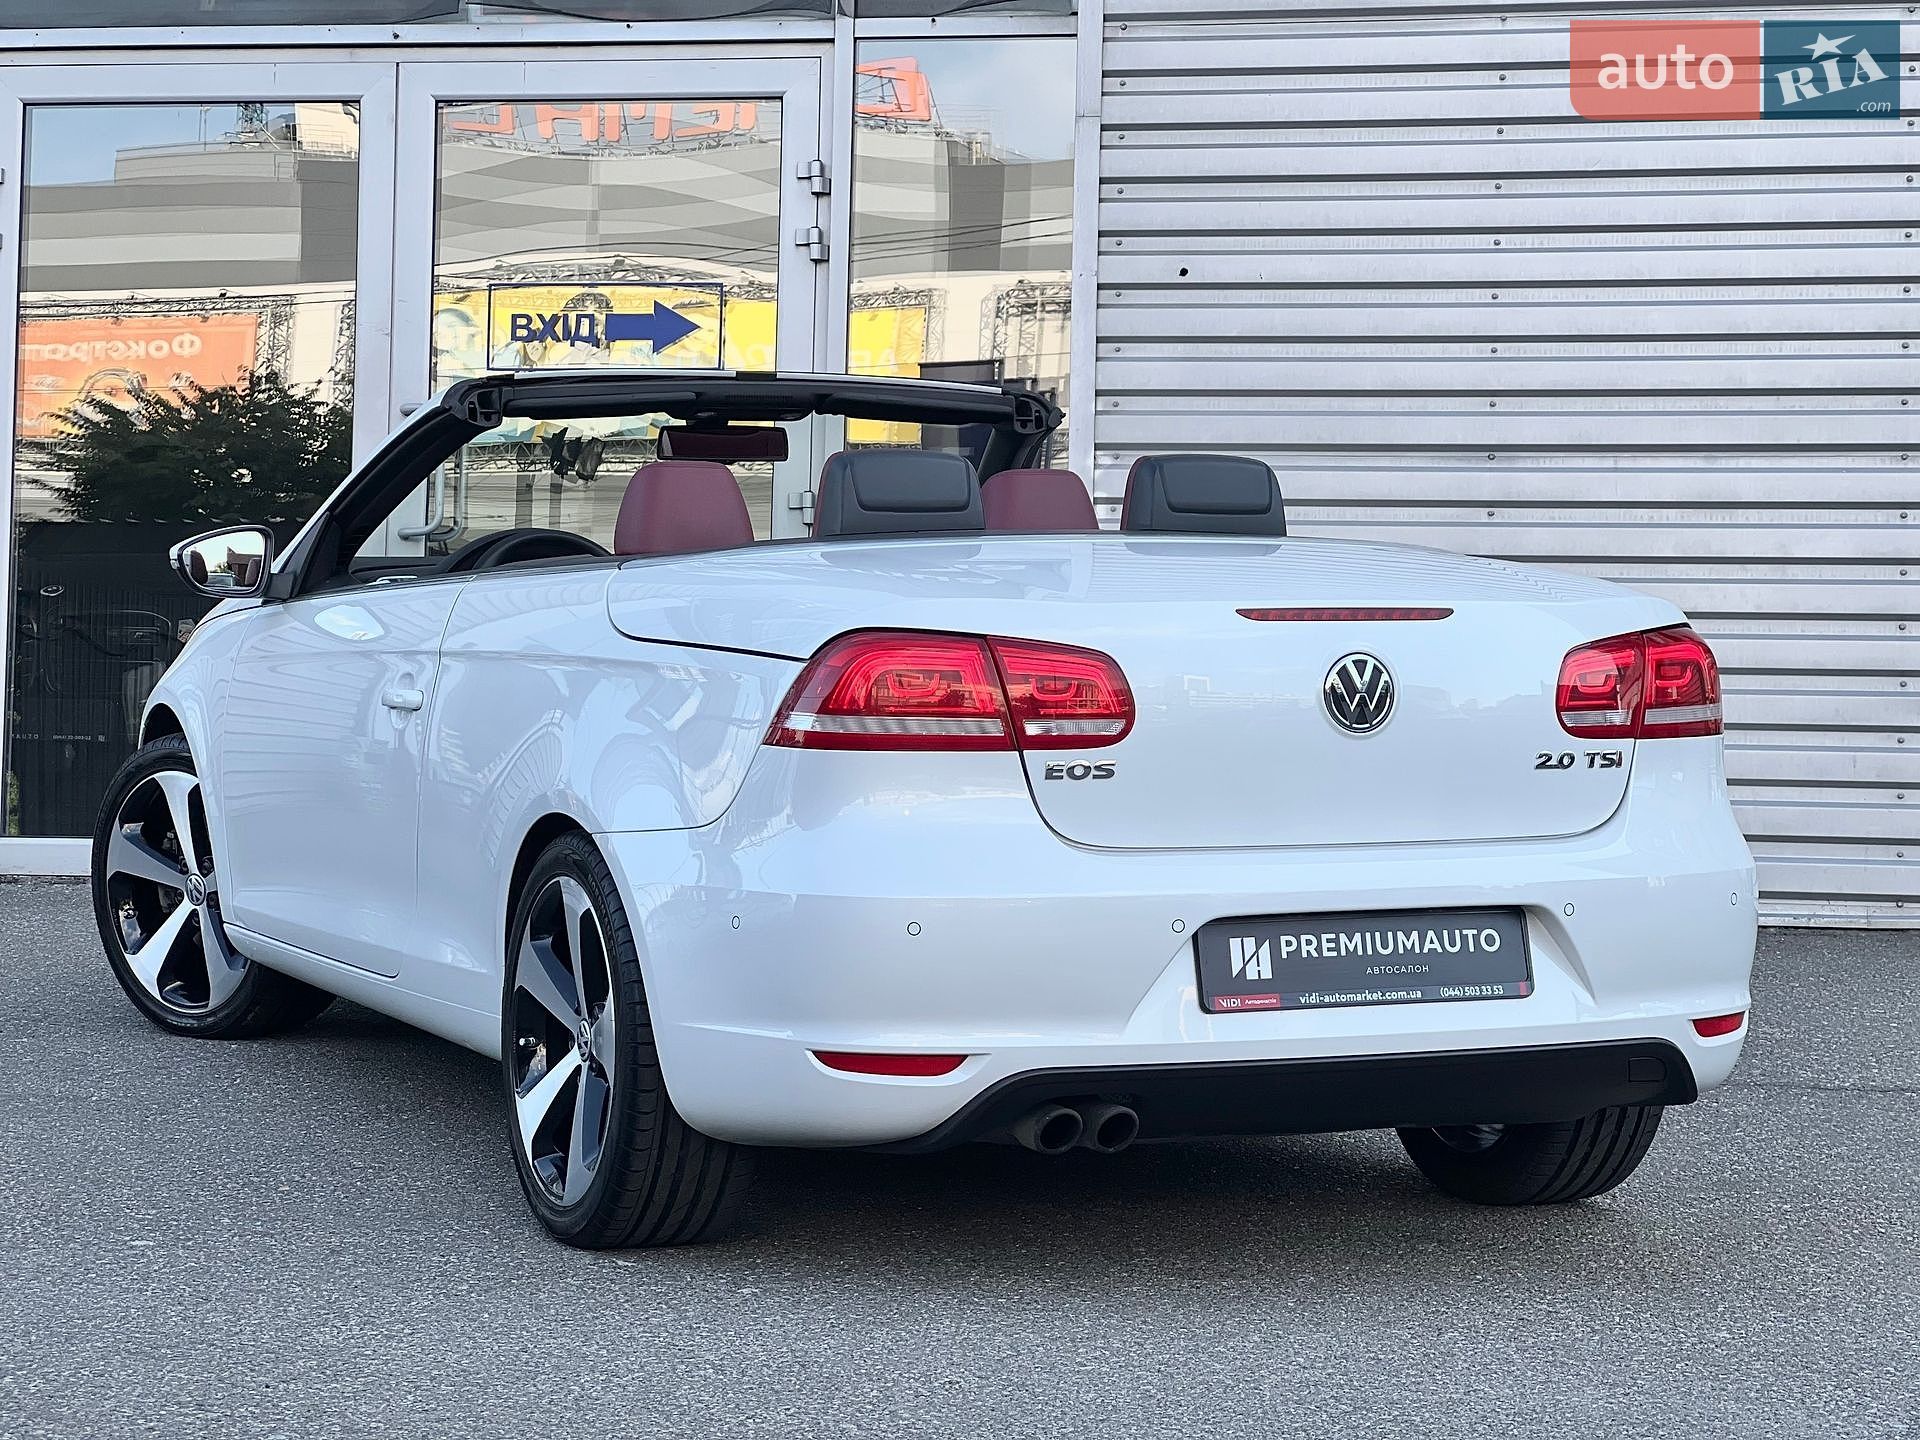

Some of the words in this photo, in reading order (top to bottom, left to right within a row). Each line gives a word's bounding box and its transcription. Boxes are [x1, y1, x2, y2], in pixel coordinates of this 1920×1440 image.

[510, 313, 600, 348] ВХІД
[1584, 750, 1623, 769] TSI
[1045, 759, 1117, 780] EOS
[1280, 928, 1501, 959] PREMIUMAUTO
[1366, 964, 1429, 975] АВТОСАЛОН
[1299, 989, 1422, 1004] vidi-automarket.com.ua
[1440, 986, 1463, 997] (044)
[1464, 986, 1480, 996] 503
[1481, 985, 1492, 995] 33
[1493, 985, 1504, 995] 53
[1218, 998, 1241, 1008] VIDI
